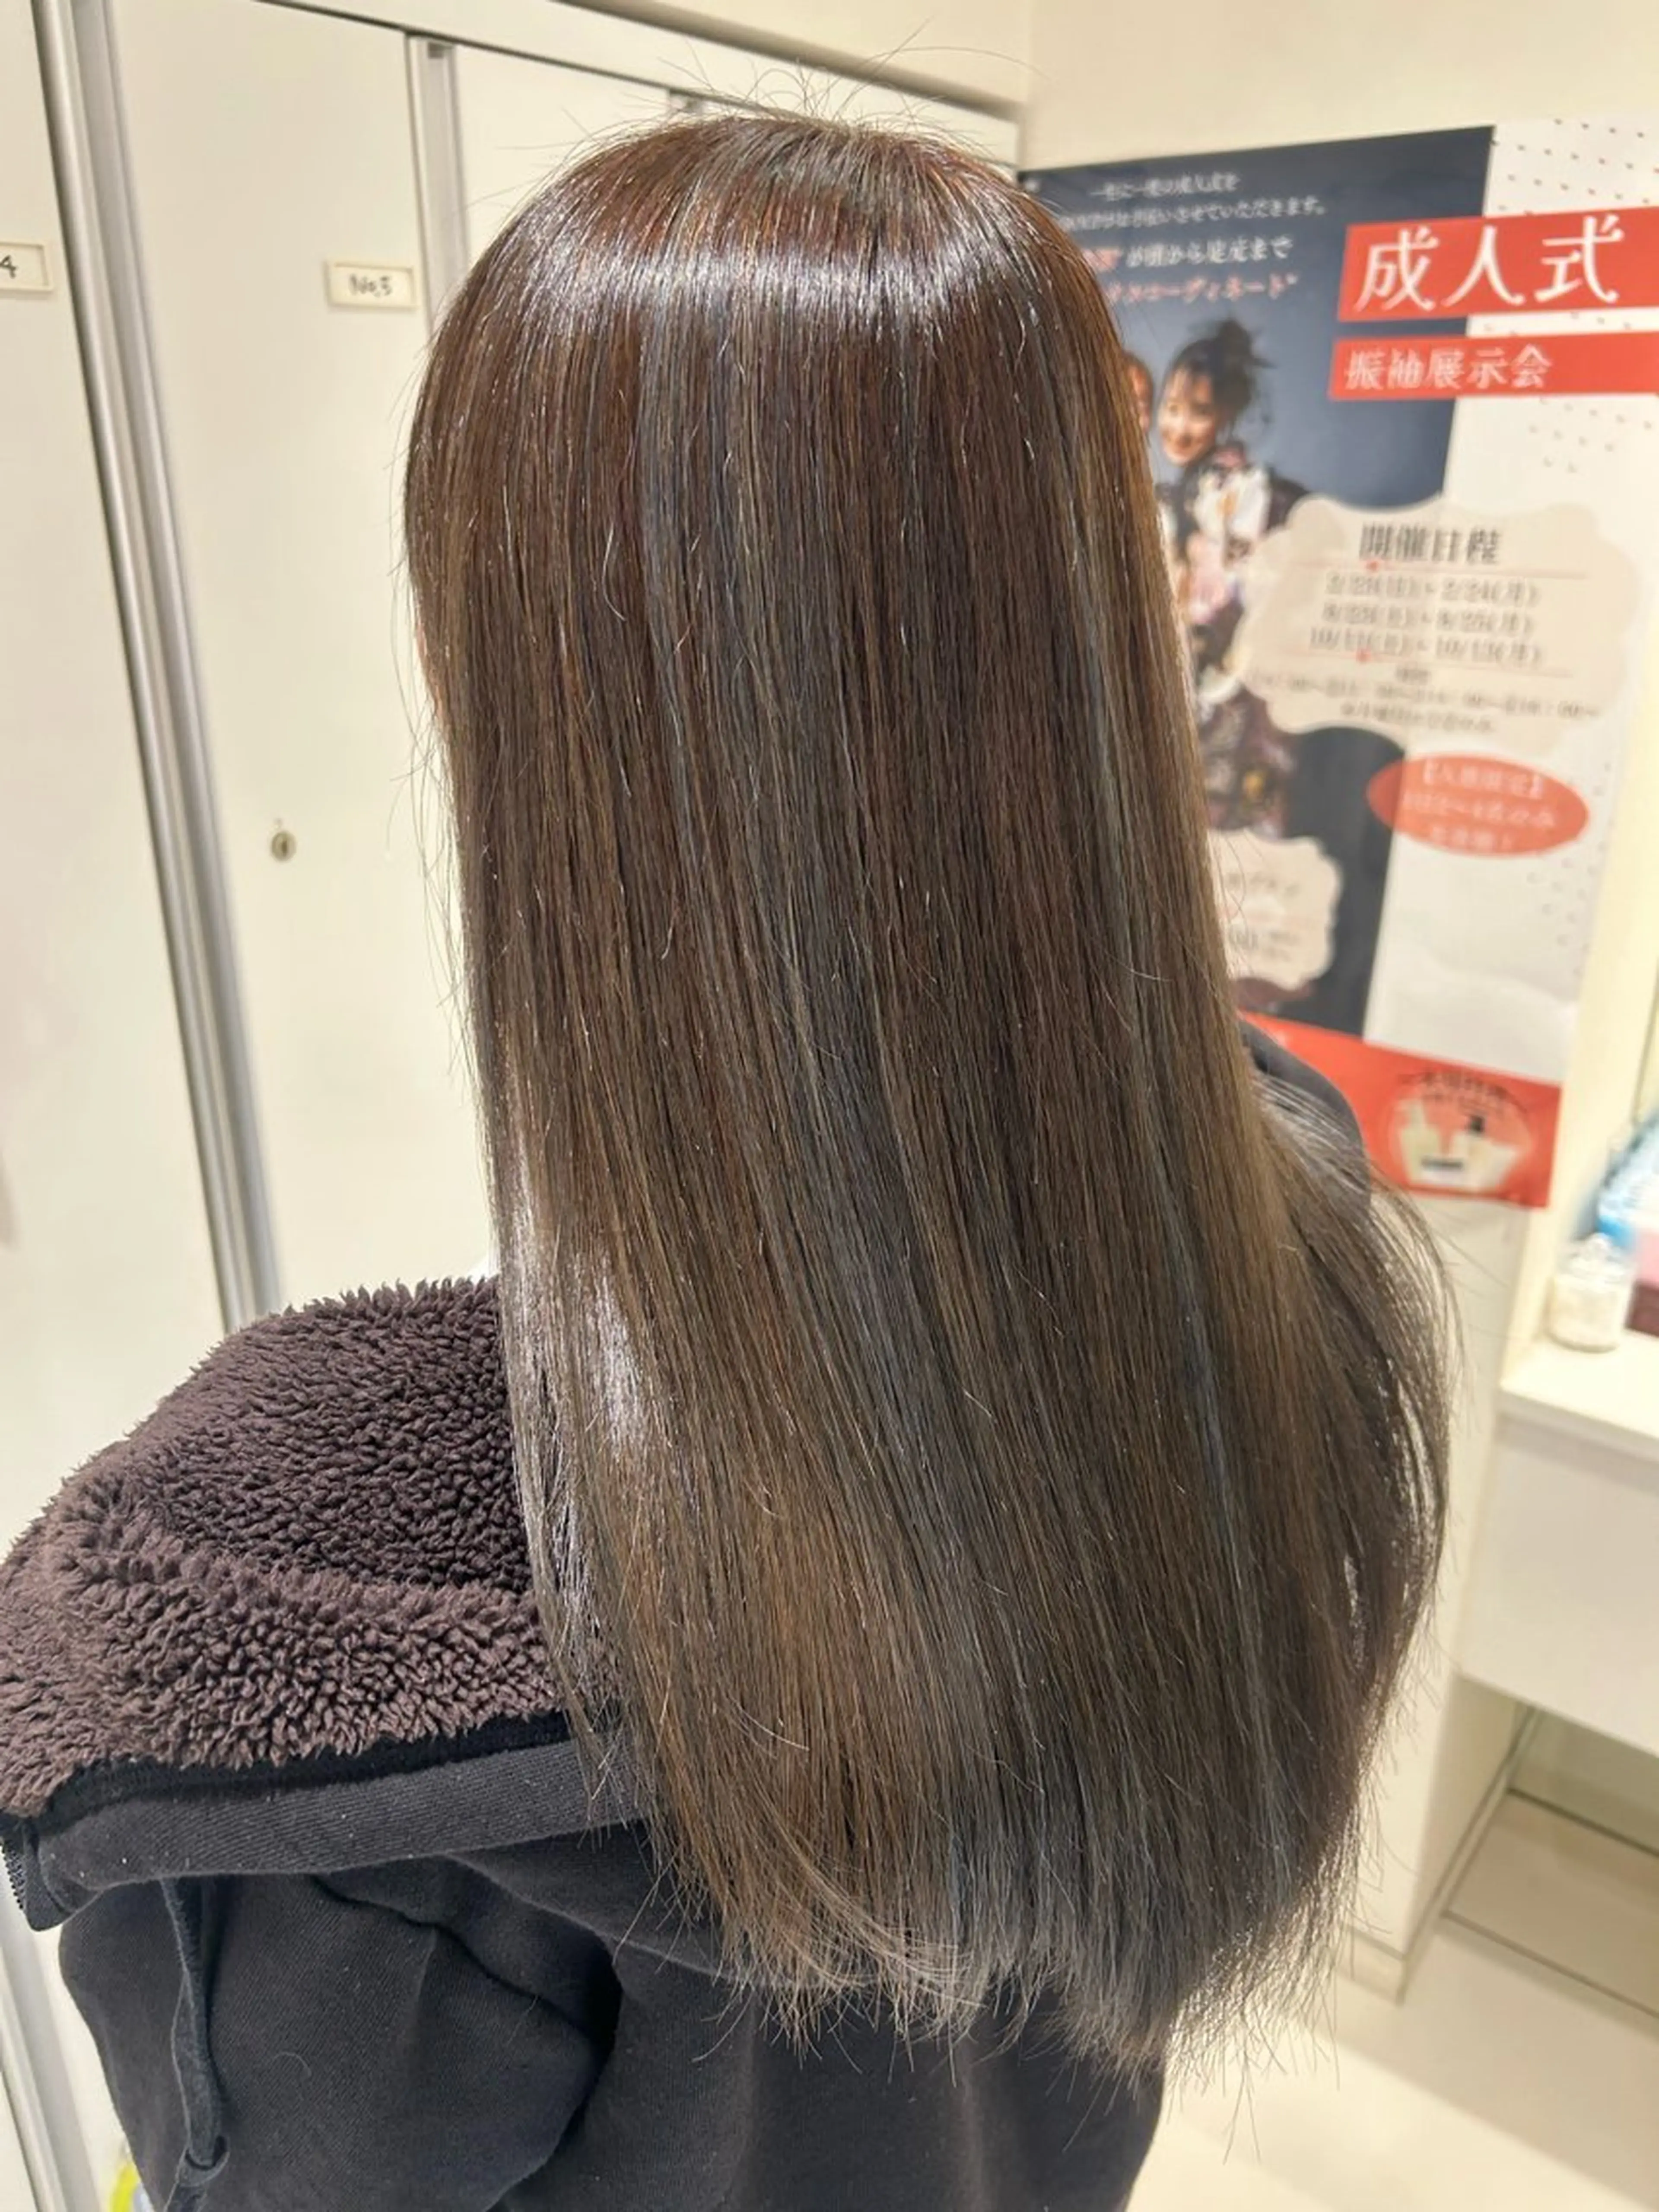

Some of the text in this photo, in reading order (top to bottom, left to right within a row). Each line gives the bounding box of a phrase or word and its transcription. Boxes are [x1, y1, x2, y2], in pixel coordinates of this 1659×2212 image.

[1353, 215, 1625, 312] 成人式
[1345, 344, 1552, 391] 振袖展示会
